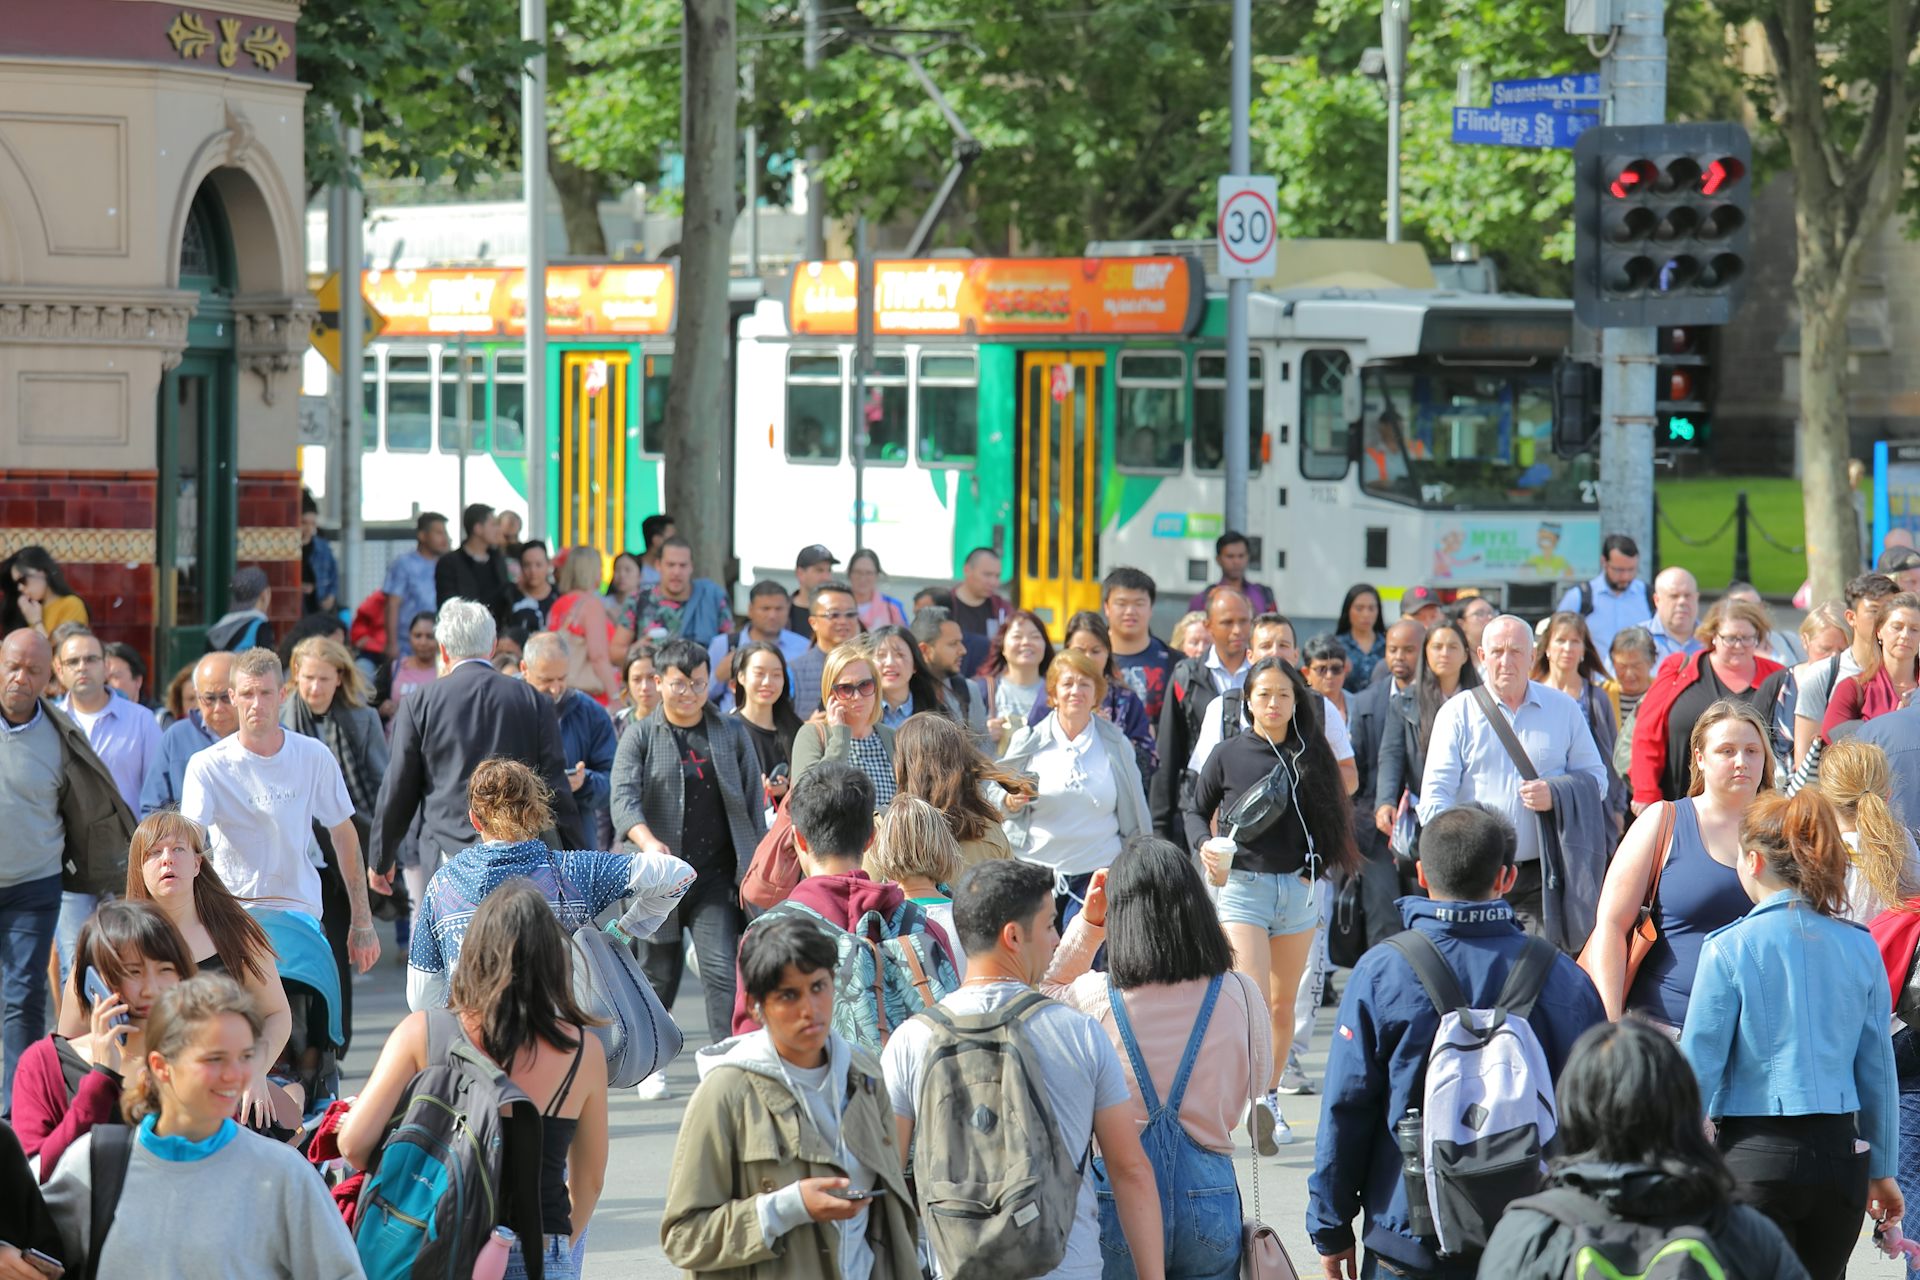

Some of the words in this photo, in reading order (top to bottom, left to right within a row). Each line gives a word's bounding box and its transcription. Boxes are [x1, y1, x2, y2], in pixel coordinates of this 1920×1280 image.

[1494, 83, 1559, 104] Swanston
[1561, 77, 1576, 95] St
[1456, 109, 1528, 133] Flinders
[1535, 112, 1555, 136] St
[1229, 210, 1268, 244] 30
[1435, 907, 1514, 923] HILFIGER
